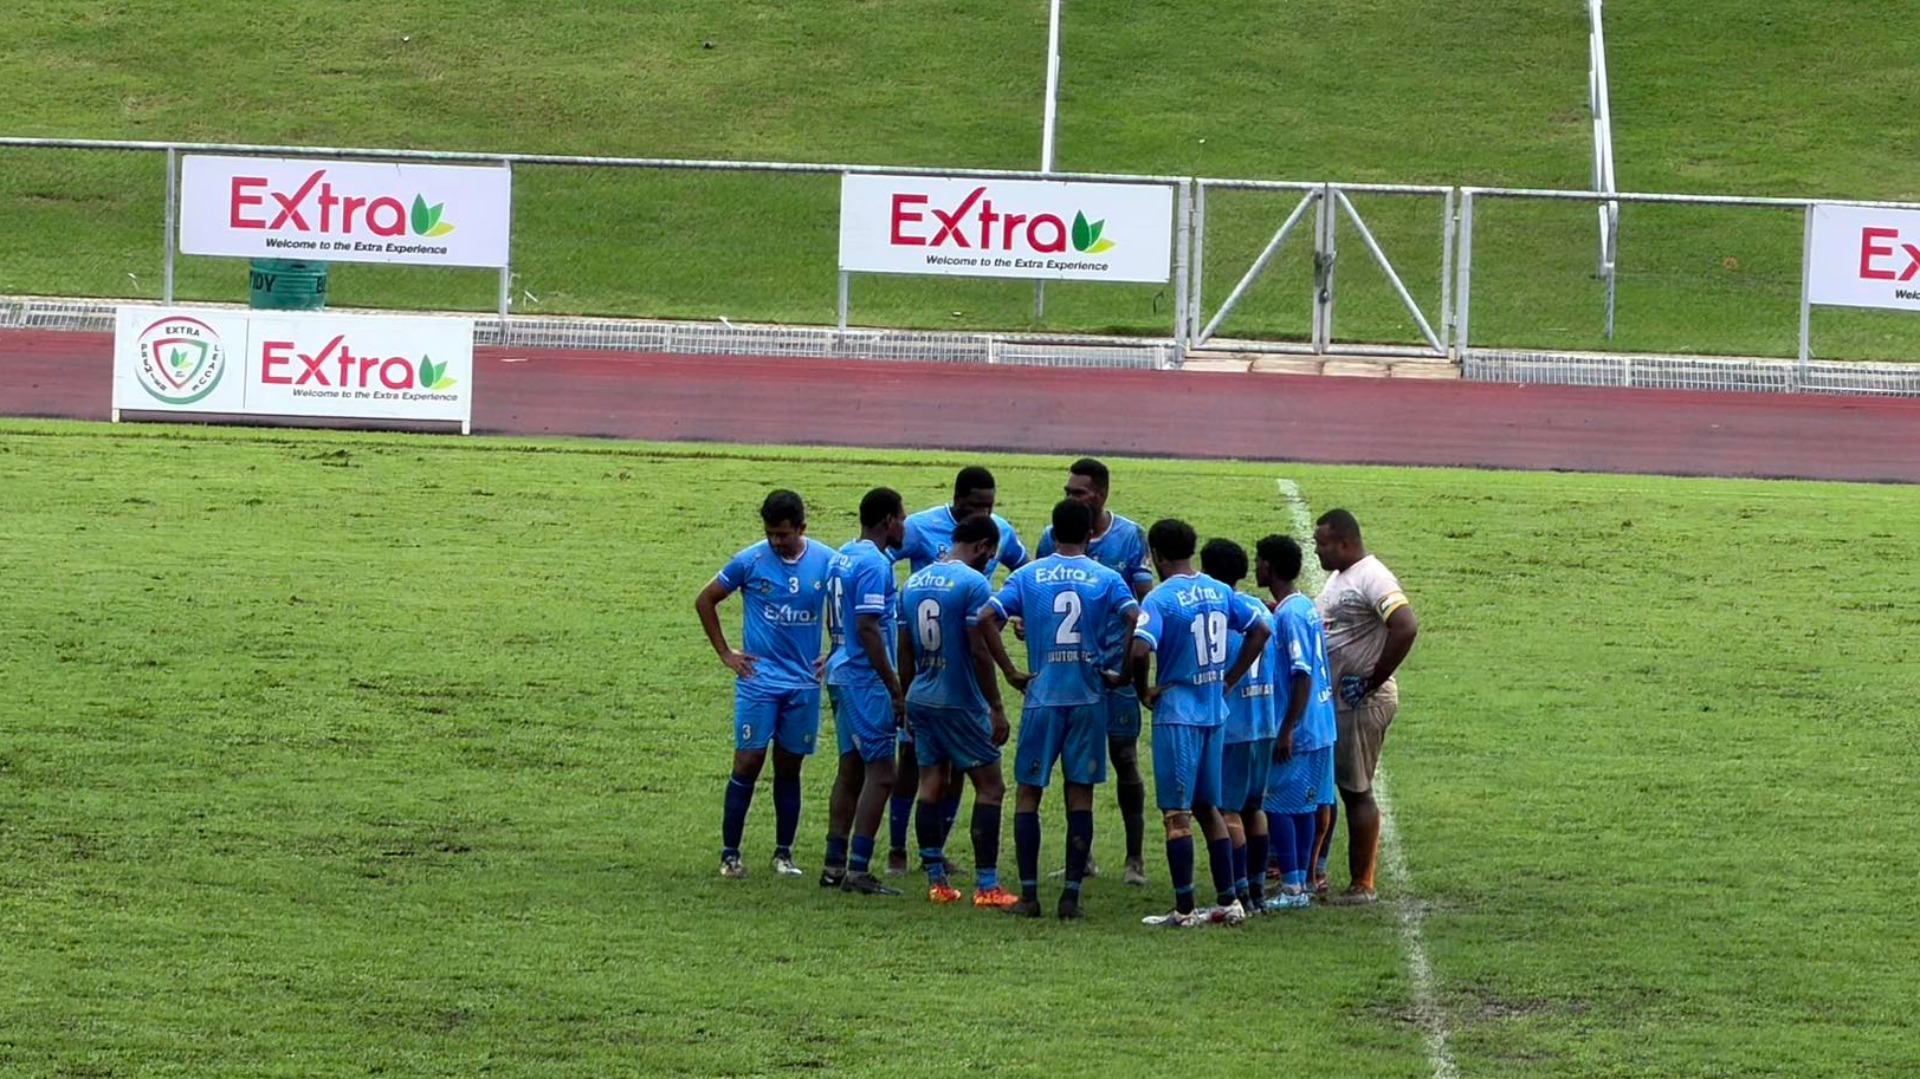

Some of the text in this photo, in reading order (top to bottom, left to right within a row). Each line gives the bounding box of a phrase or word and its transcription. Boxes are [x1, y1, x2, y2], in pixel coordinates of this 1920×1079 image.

[230, 169, 407, 237] Extra
[890, 187, 1067, 253] Extra
[265, 238, 447, 255] Welcome to the Extra Experience
[926, 255, 1109, 272] Welcome to the Extra Experience
[165, 326, 200, 337] EXTRA
[261, 334, 414, 390] Extra
[293, 388, 458, 402] Welcome to the Extra Experience
[907, 571, 945, 588] Extra
[1036, 563, 1087, 583] Extra
[788, 577, 799, 594] 3
[1177, 583, 1217, 607] Extra
[764, 603, 811, 622] Extra
[1054, 591, 1081, 644] 2
[918, 599, 941, 651] 6
[1190, 611, 1227, 666] 19
[742, 724, 751, 740] 3
